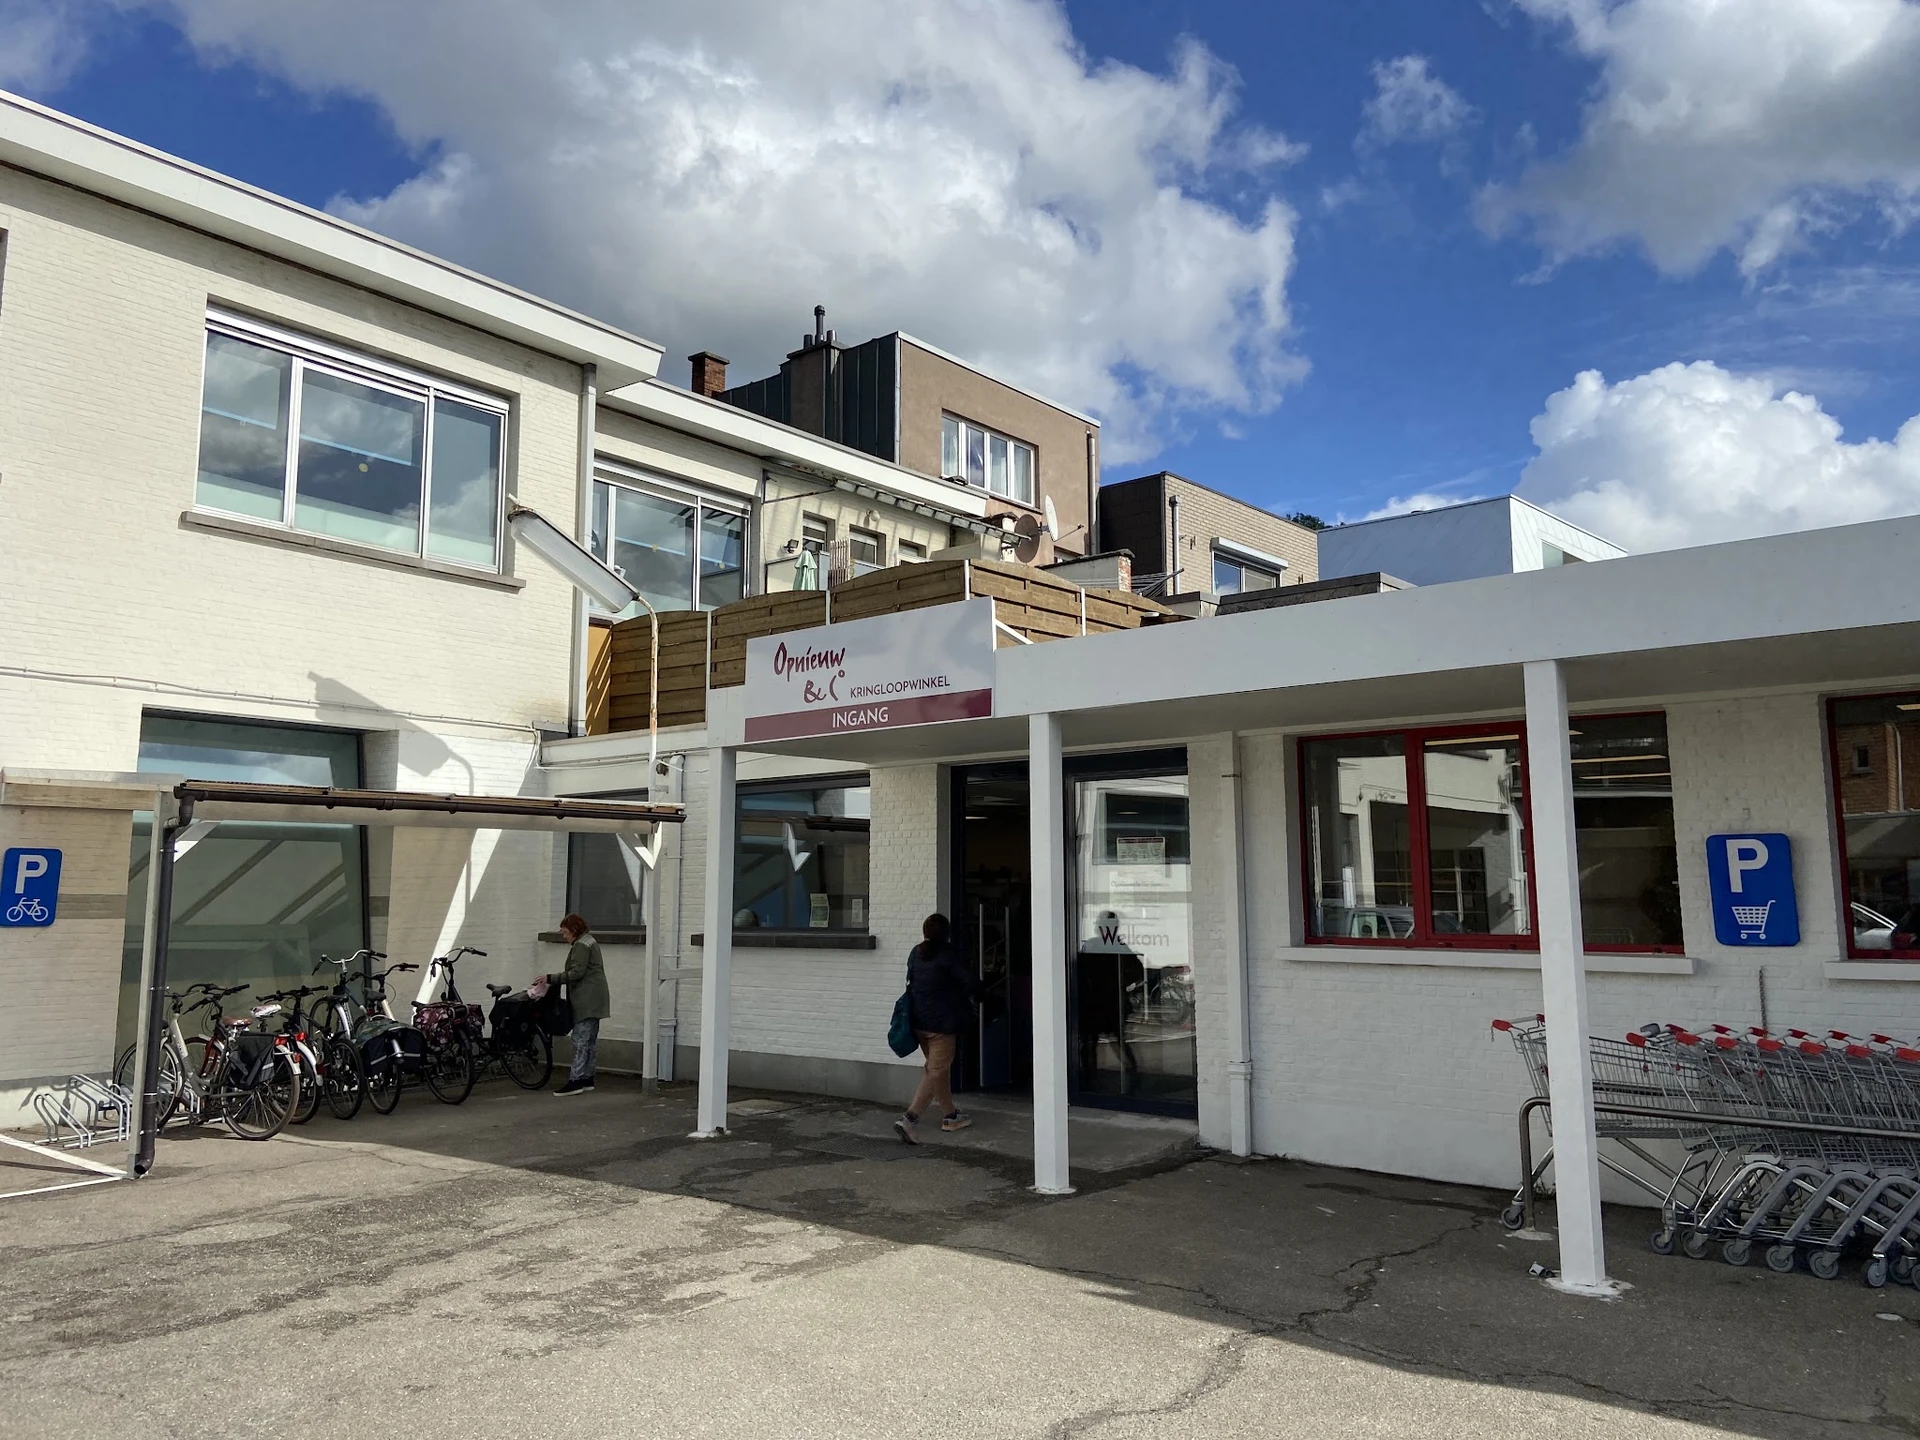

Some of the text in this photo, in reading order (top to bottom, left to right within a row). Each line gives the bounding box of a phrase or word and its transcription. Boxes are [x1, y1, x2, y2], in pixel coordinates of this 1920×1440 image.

[773, 641, 846, 682] Opnieuw
[803, 679, 827, 704] &
[850, 675, 951, 699] KRINGLOOPWINKEL
[832, 706, 889, 728] INGANG
[15, 854, 49, 894] P
[1725, 838, 1769, 893] P
[1098, 924, 1170, 946] Welkom
